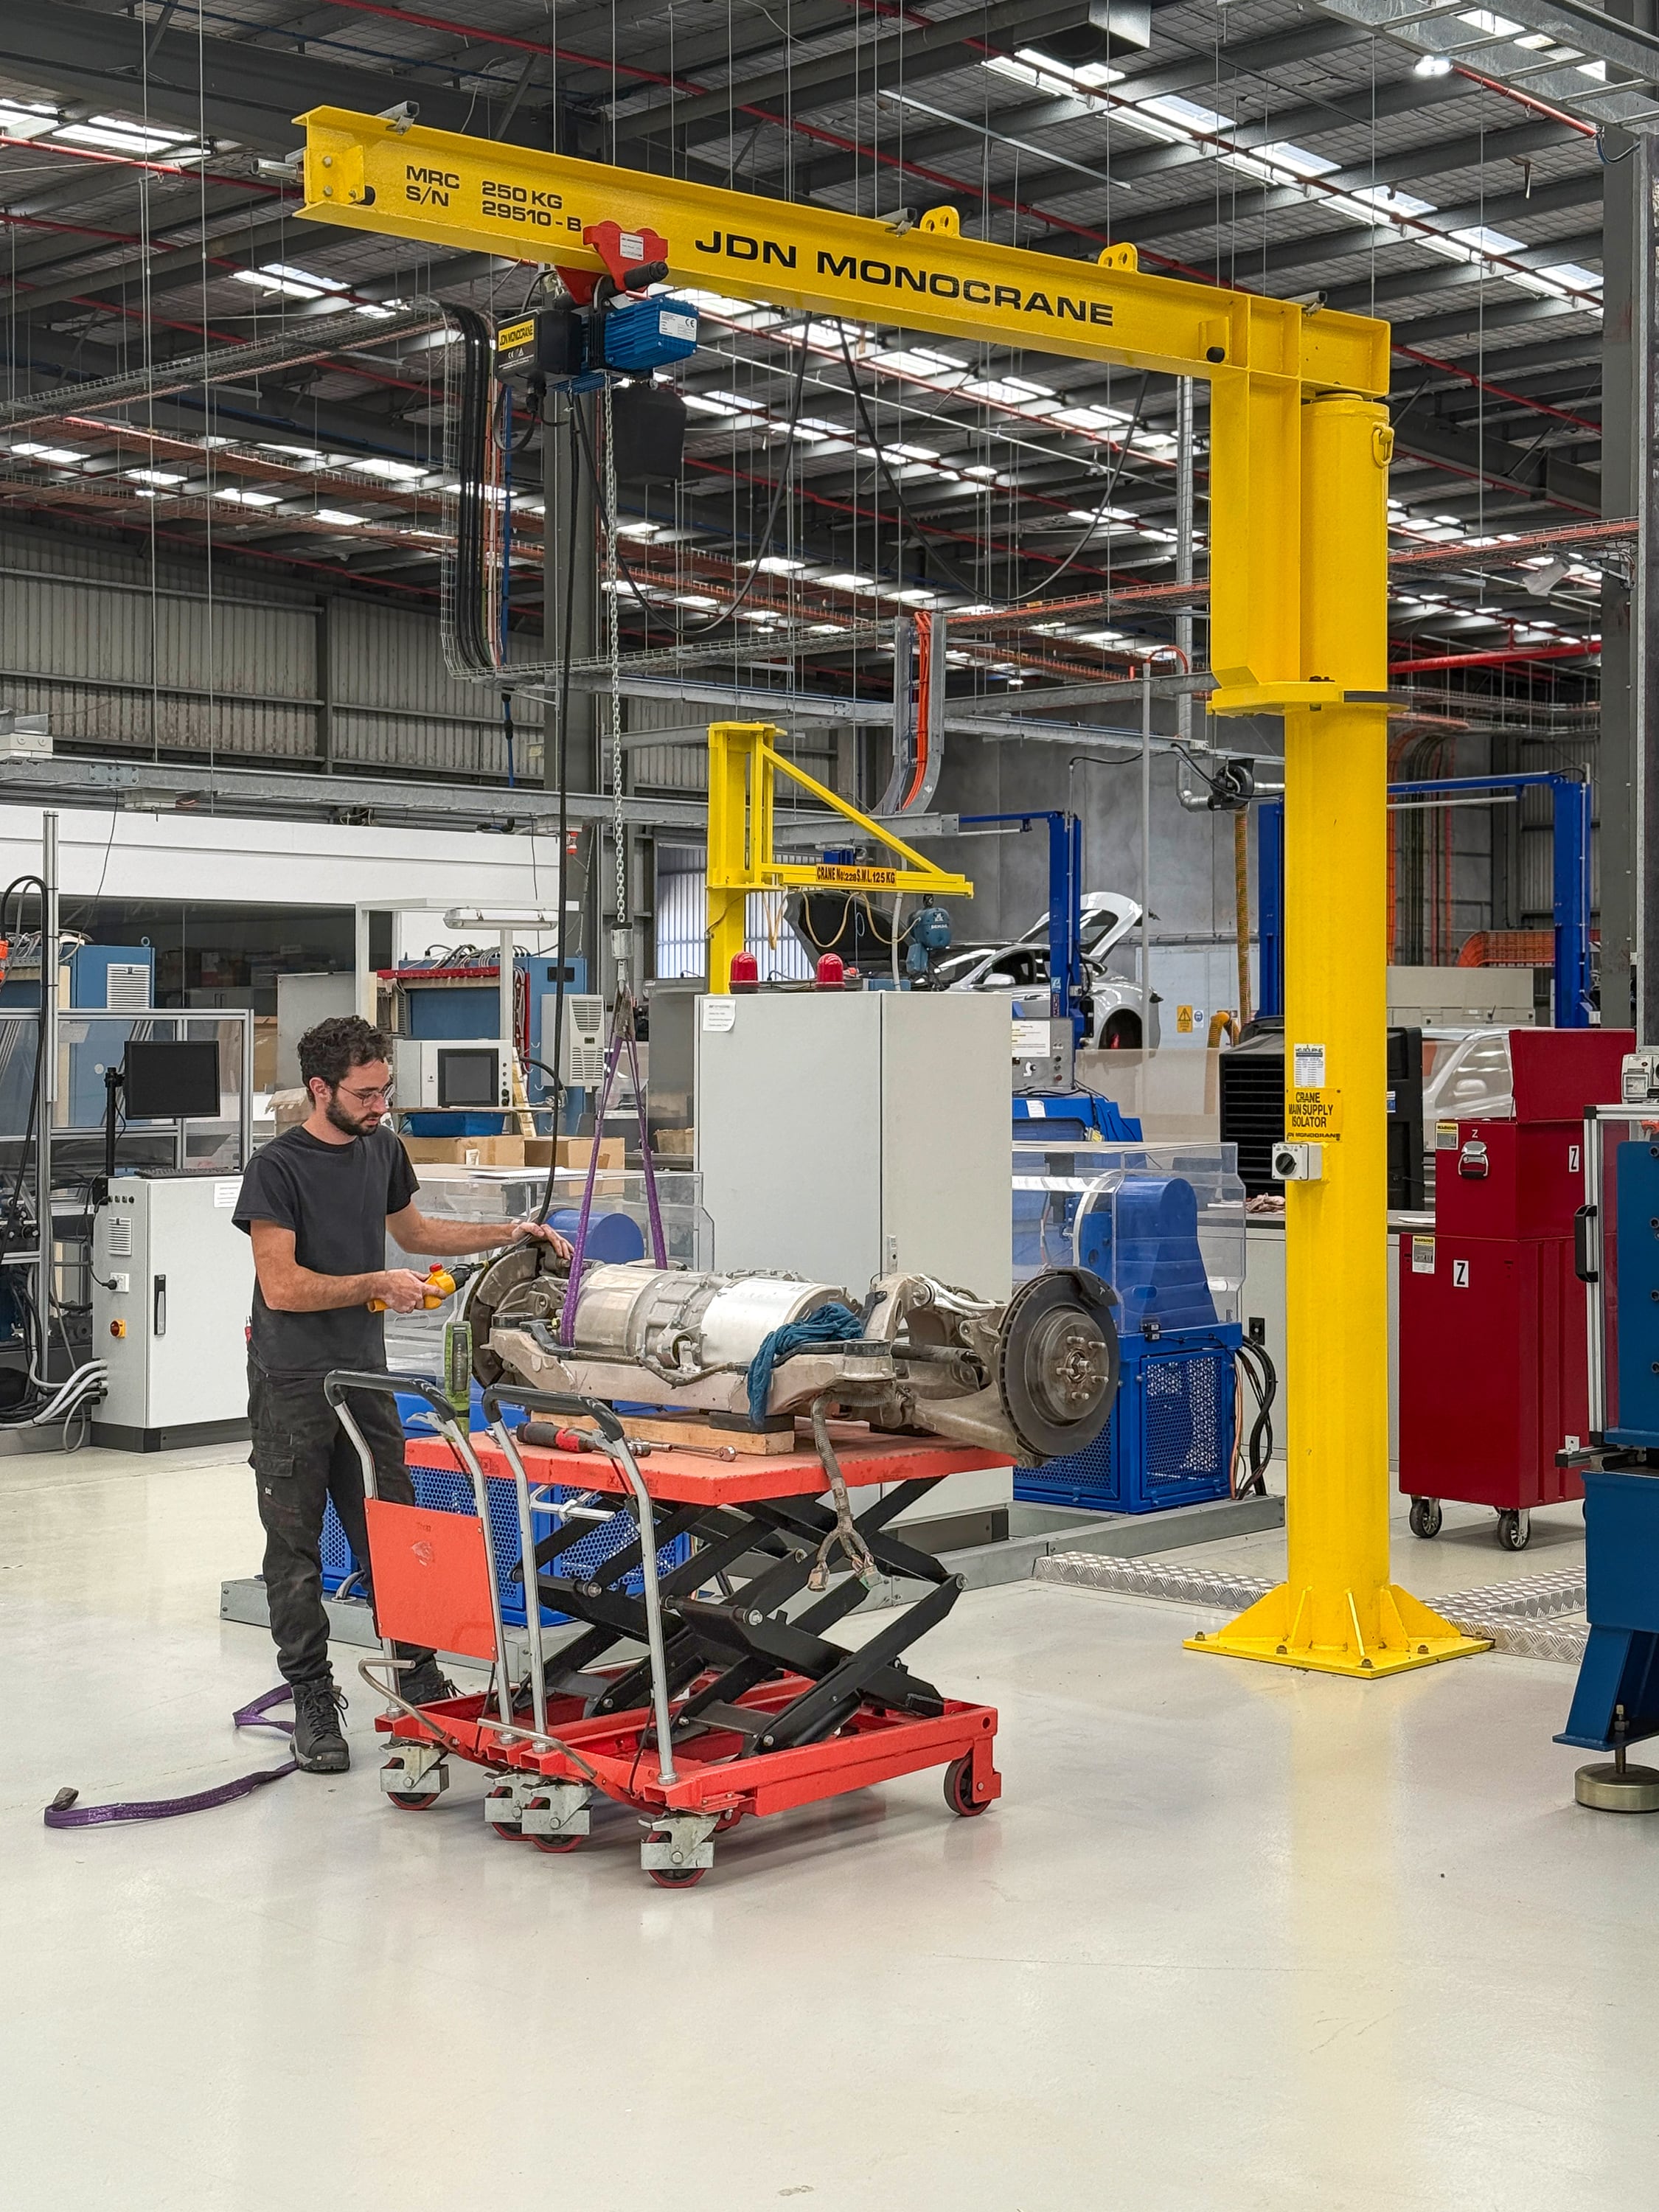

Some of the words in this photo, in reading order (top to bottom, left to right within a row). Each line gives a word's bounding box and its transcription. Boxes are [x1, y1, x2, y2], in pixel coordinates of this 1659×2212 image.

[406, 164, 460, 189] MRC
[406, 185, 449, 207] S/N
[481, 181, 529, 203] 250
[531, 189, 563, 209] KG
[481, 200, 552, 227] 29510
[695, 231, 797, 268] JDN
[817, 251, 1114, 327] MONOCRANE
[817, 866, 835, 880] CRANE
[873, 872, 885, 883] 125
[886, 872, 895, 884] KG
[1295, 1091, 1321, 1103] CRANE
[1288, 1104, 1301, 1115] MAIN
[1302, 1104, 1334, 1116] SUPPLY
[1292, 1116, 1326, 1128] ISOLATOR
[1472, 1130, 1478, 1138] Z
[1571, 1147, 1577, 1170] Z
[1457, 1262, 1466, 1285] Z
